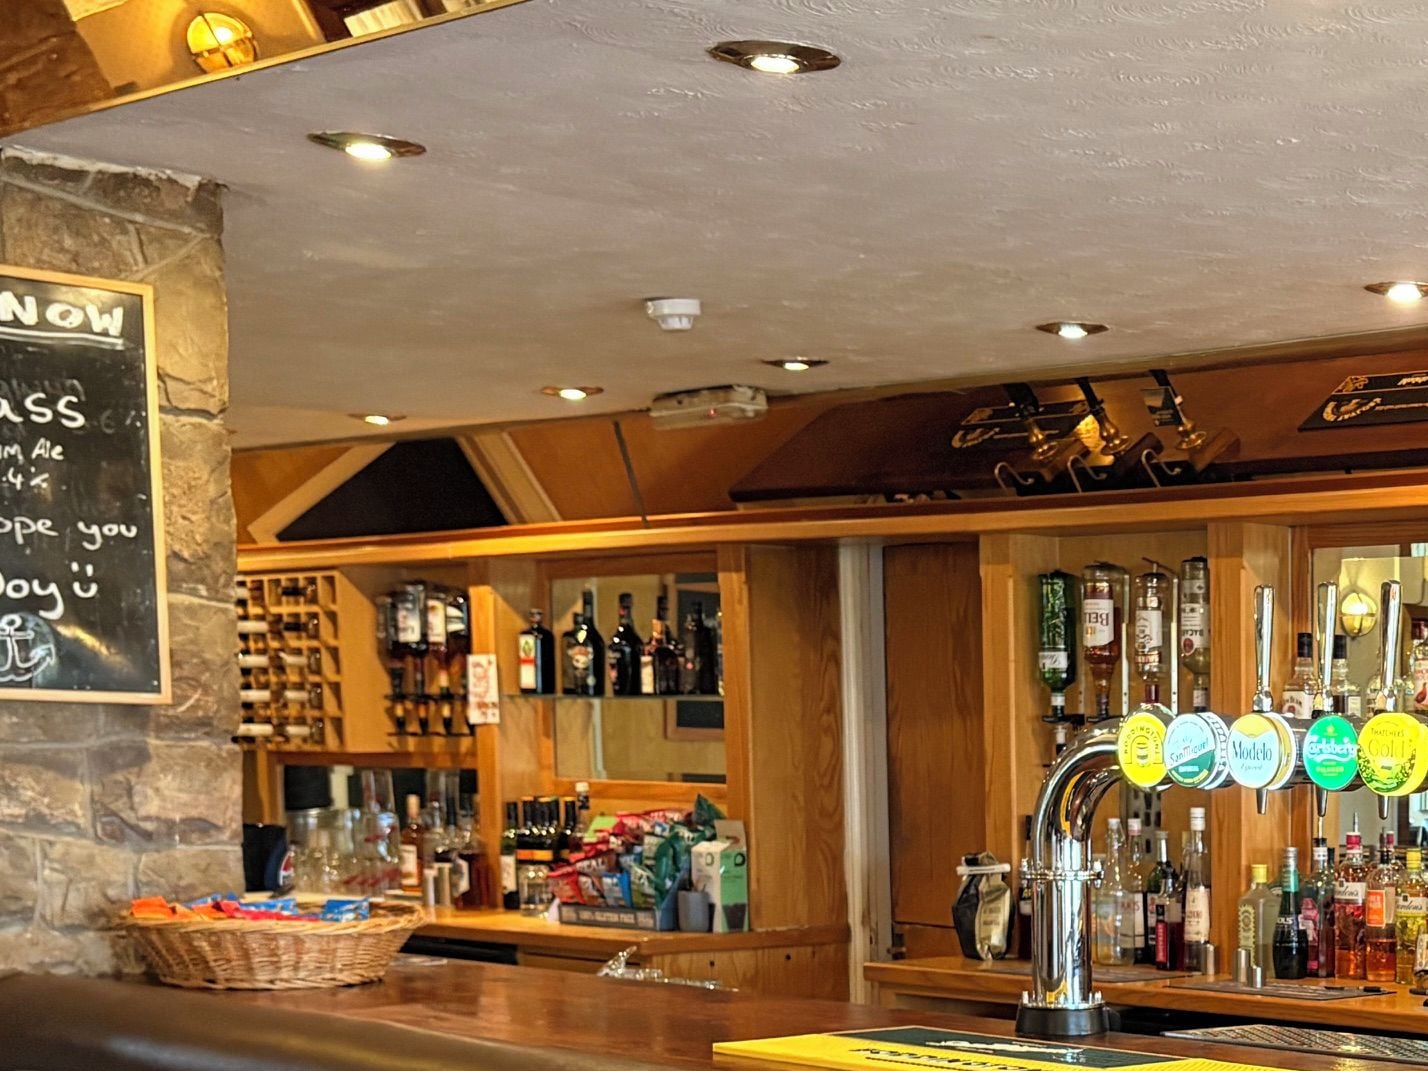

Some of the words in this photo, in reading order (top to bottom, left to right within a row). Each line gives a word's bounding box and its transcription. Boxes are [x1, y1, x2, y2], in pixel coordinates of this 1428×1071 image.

[0, 290, 124, 336] NOW
[31, 437, 65, 460] Ale
[77, 521, 138, 550] you
[1232, 740, 1273, 761] Modelo
[1307, 735, 1360, 762] Carlsberg
